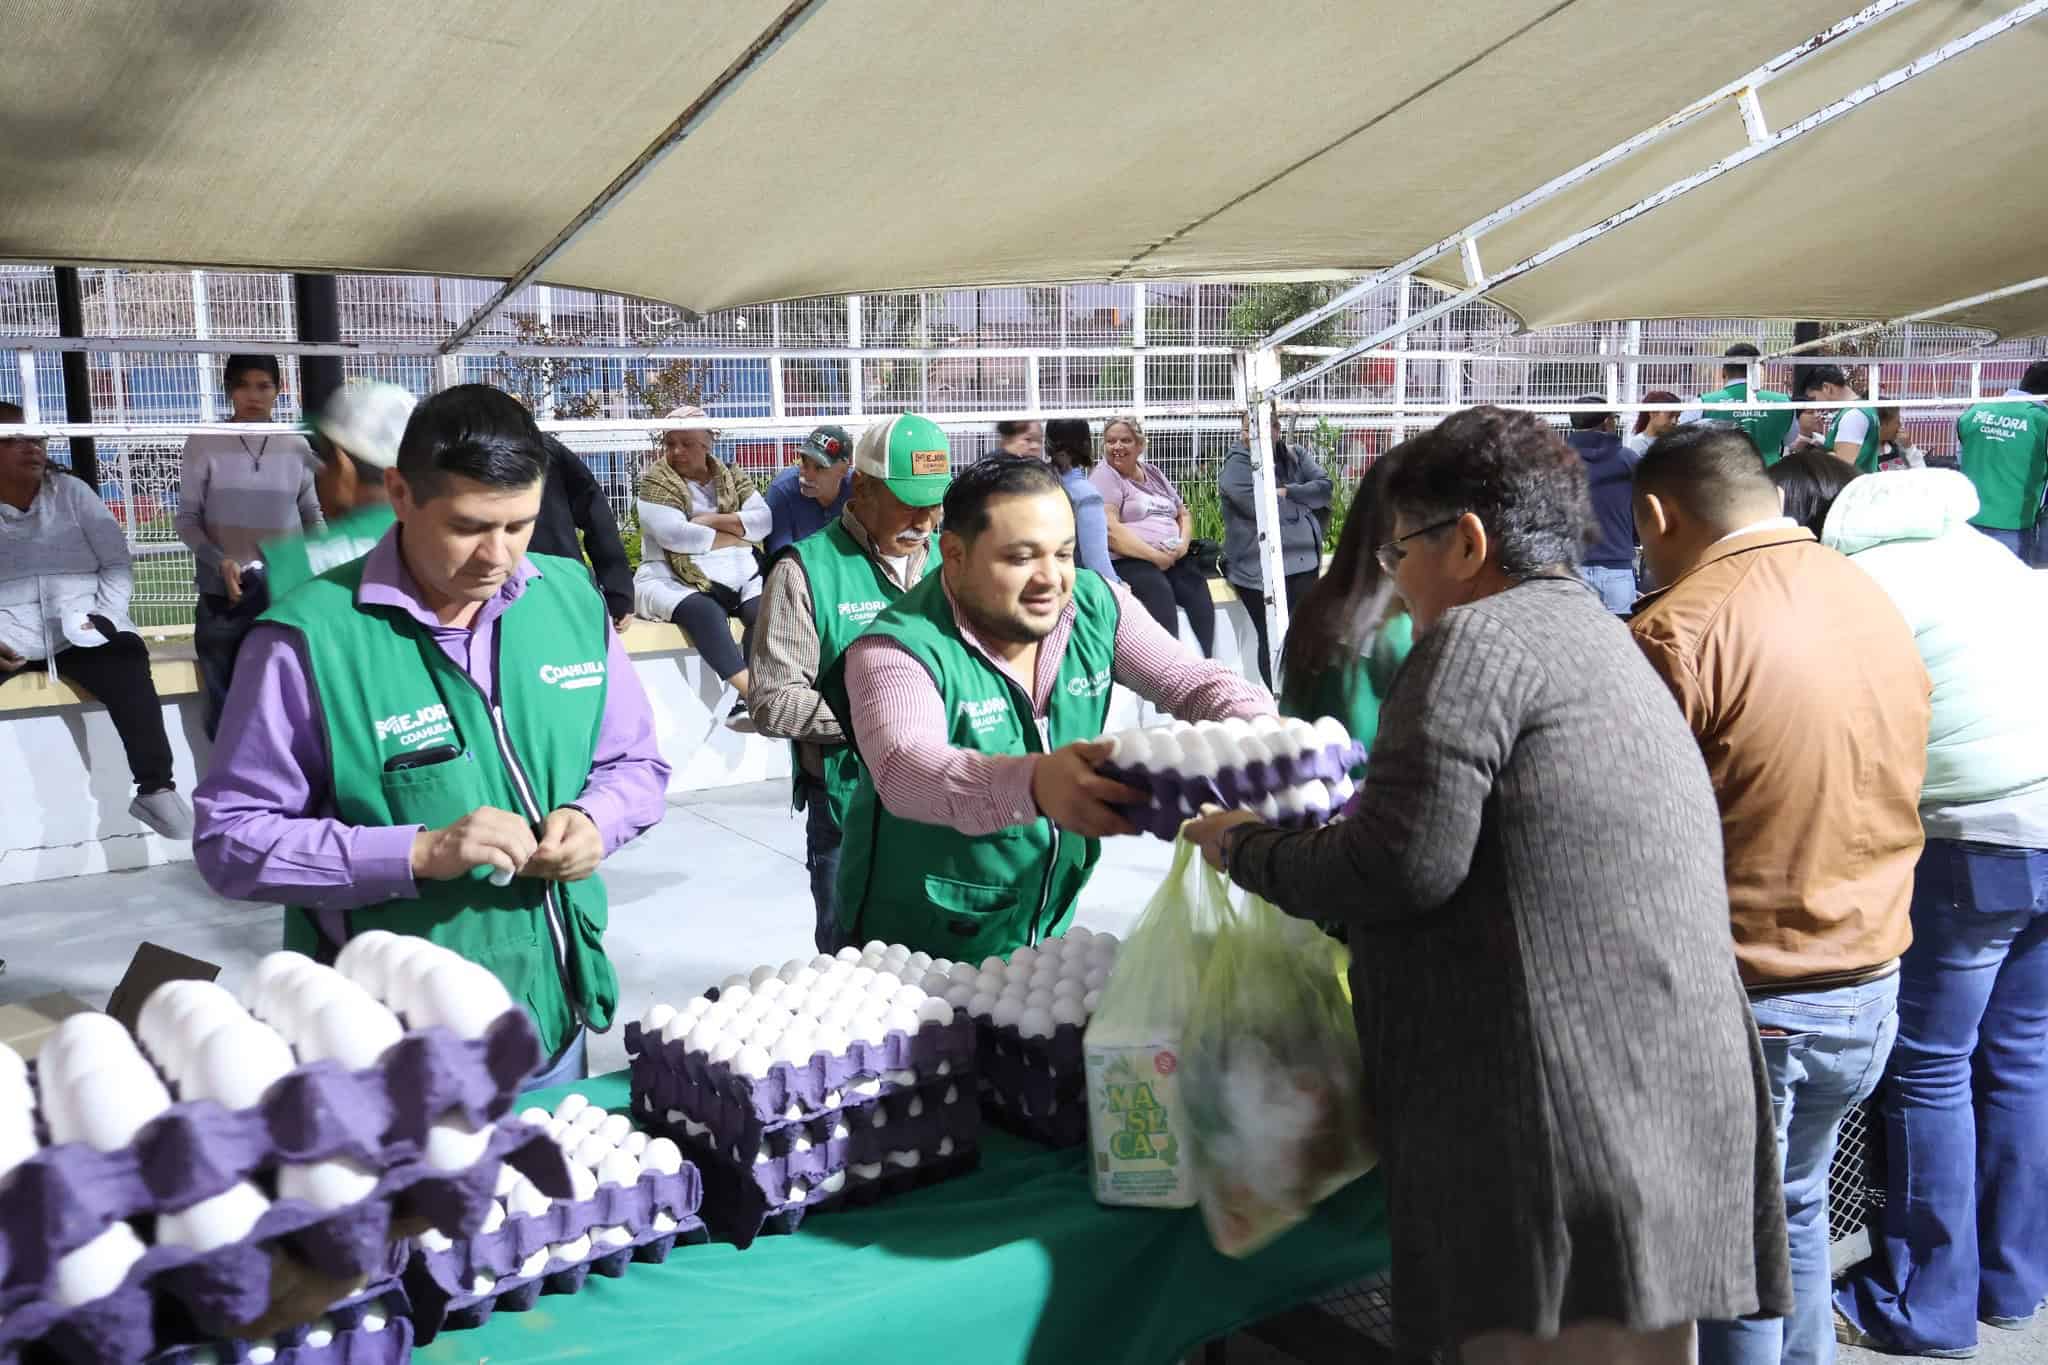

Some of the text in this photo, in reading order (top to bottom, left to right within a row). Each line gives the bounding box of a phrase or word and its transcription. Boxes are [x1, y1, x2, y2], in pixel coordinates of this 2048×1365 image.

[1972, 410, 2028, 432] MEJORA
[539, 660, 606, 685] COAHUILA
[375, 703, 449, 741] MEJOR
[400, 721, 453, 745] COAHUILA
